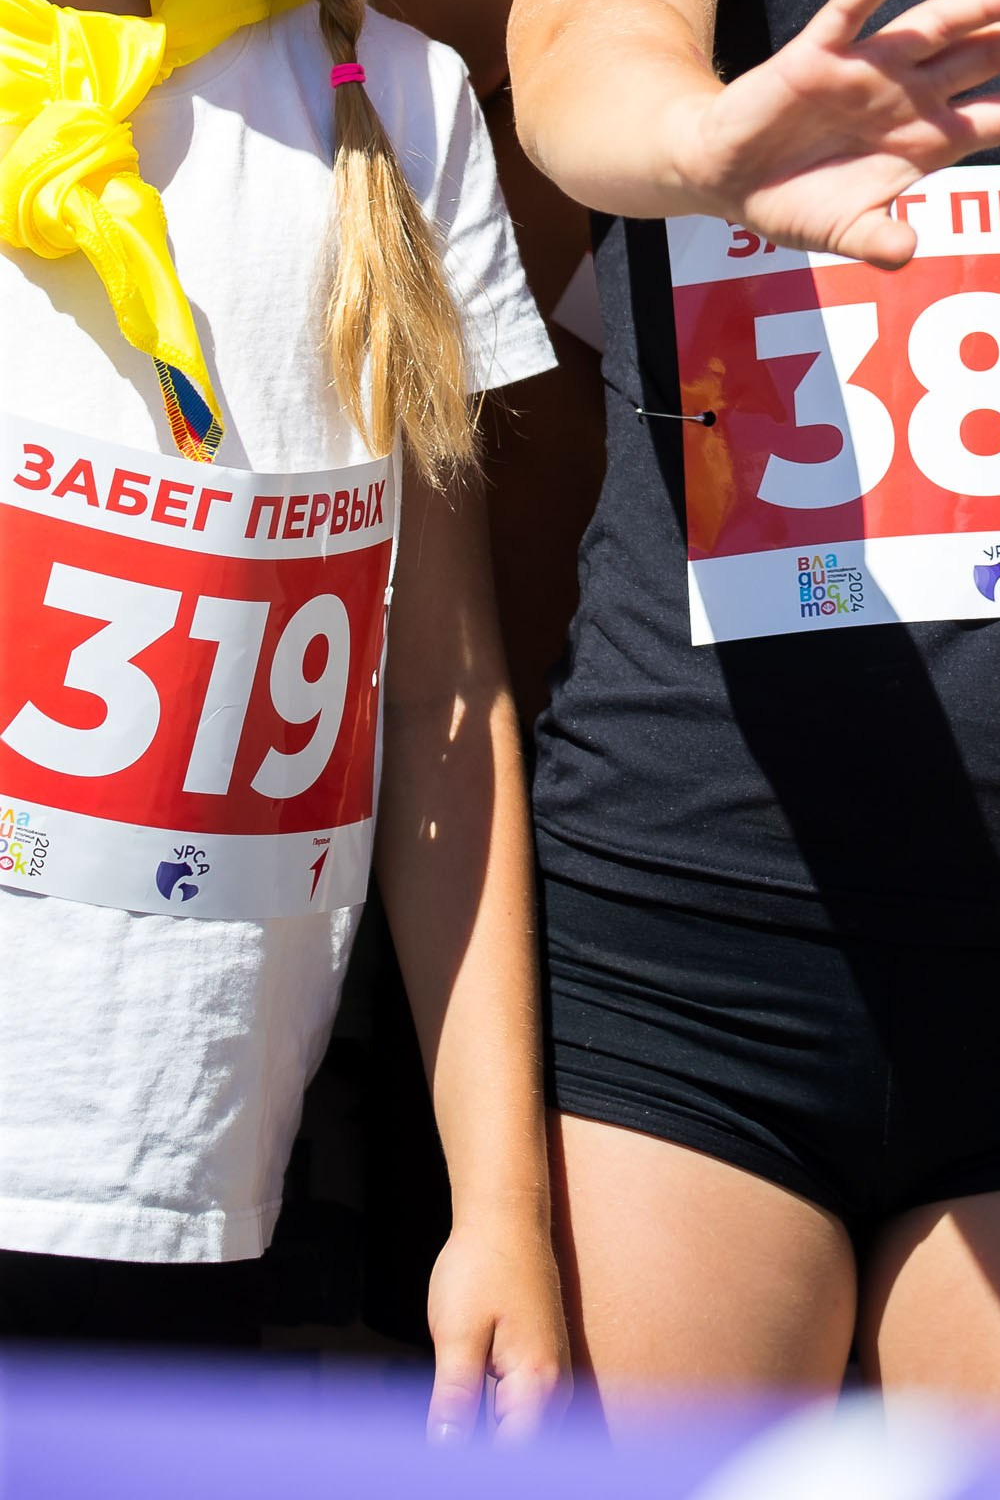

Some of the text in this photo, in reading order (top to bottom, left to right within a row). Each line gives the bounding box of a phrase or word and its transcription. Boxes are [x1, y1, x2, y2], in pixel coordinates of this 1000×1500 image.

[12, 442, 387, 541] ЗАБЕГ ПЕРВЫХ
[848, 571, 865, 613] 2024
[0, 560, 351, 800] 319
[27, 837, 50, 877] 2024
[173, 845, 211, 877] УРСА
